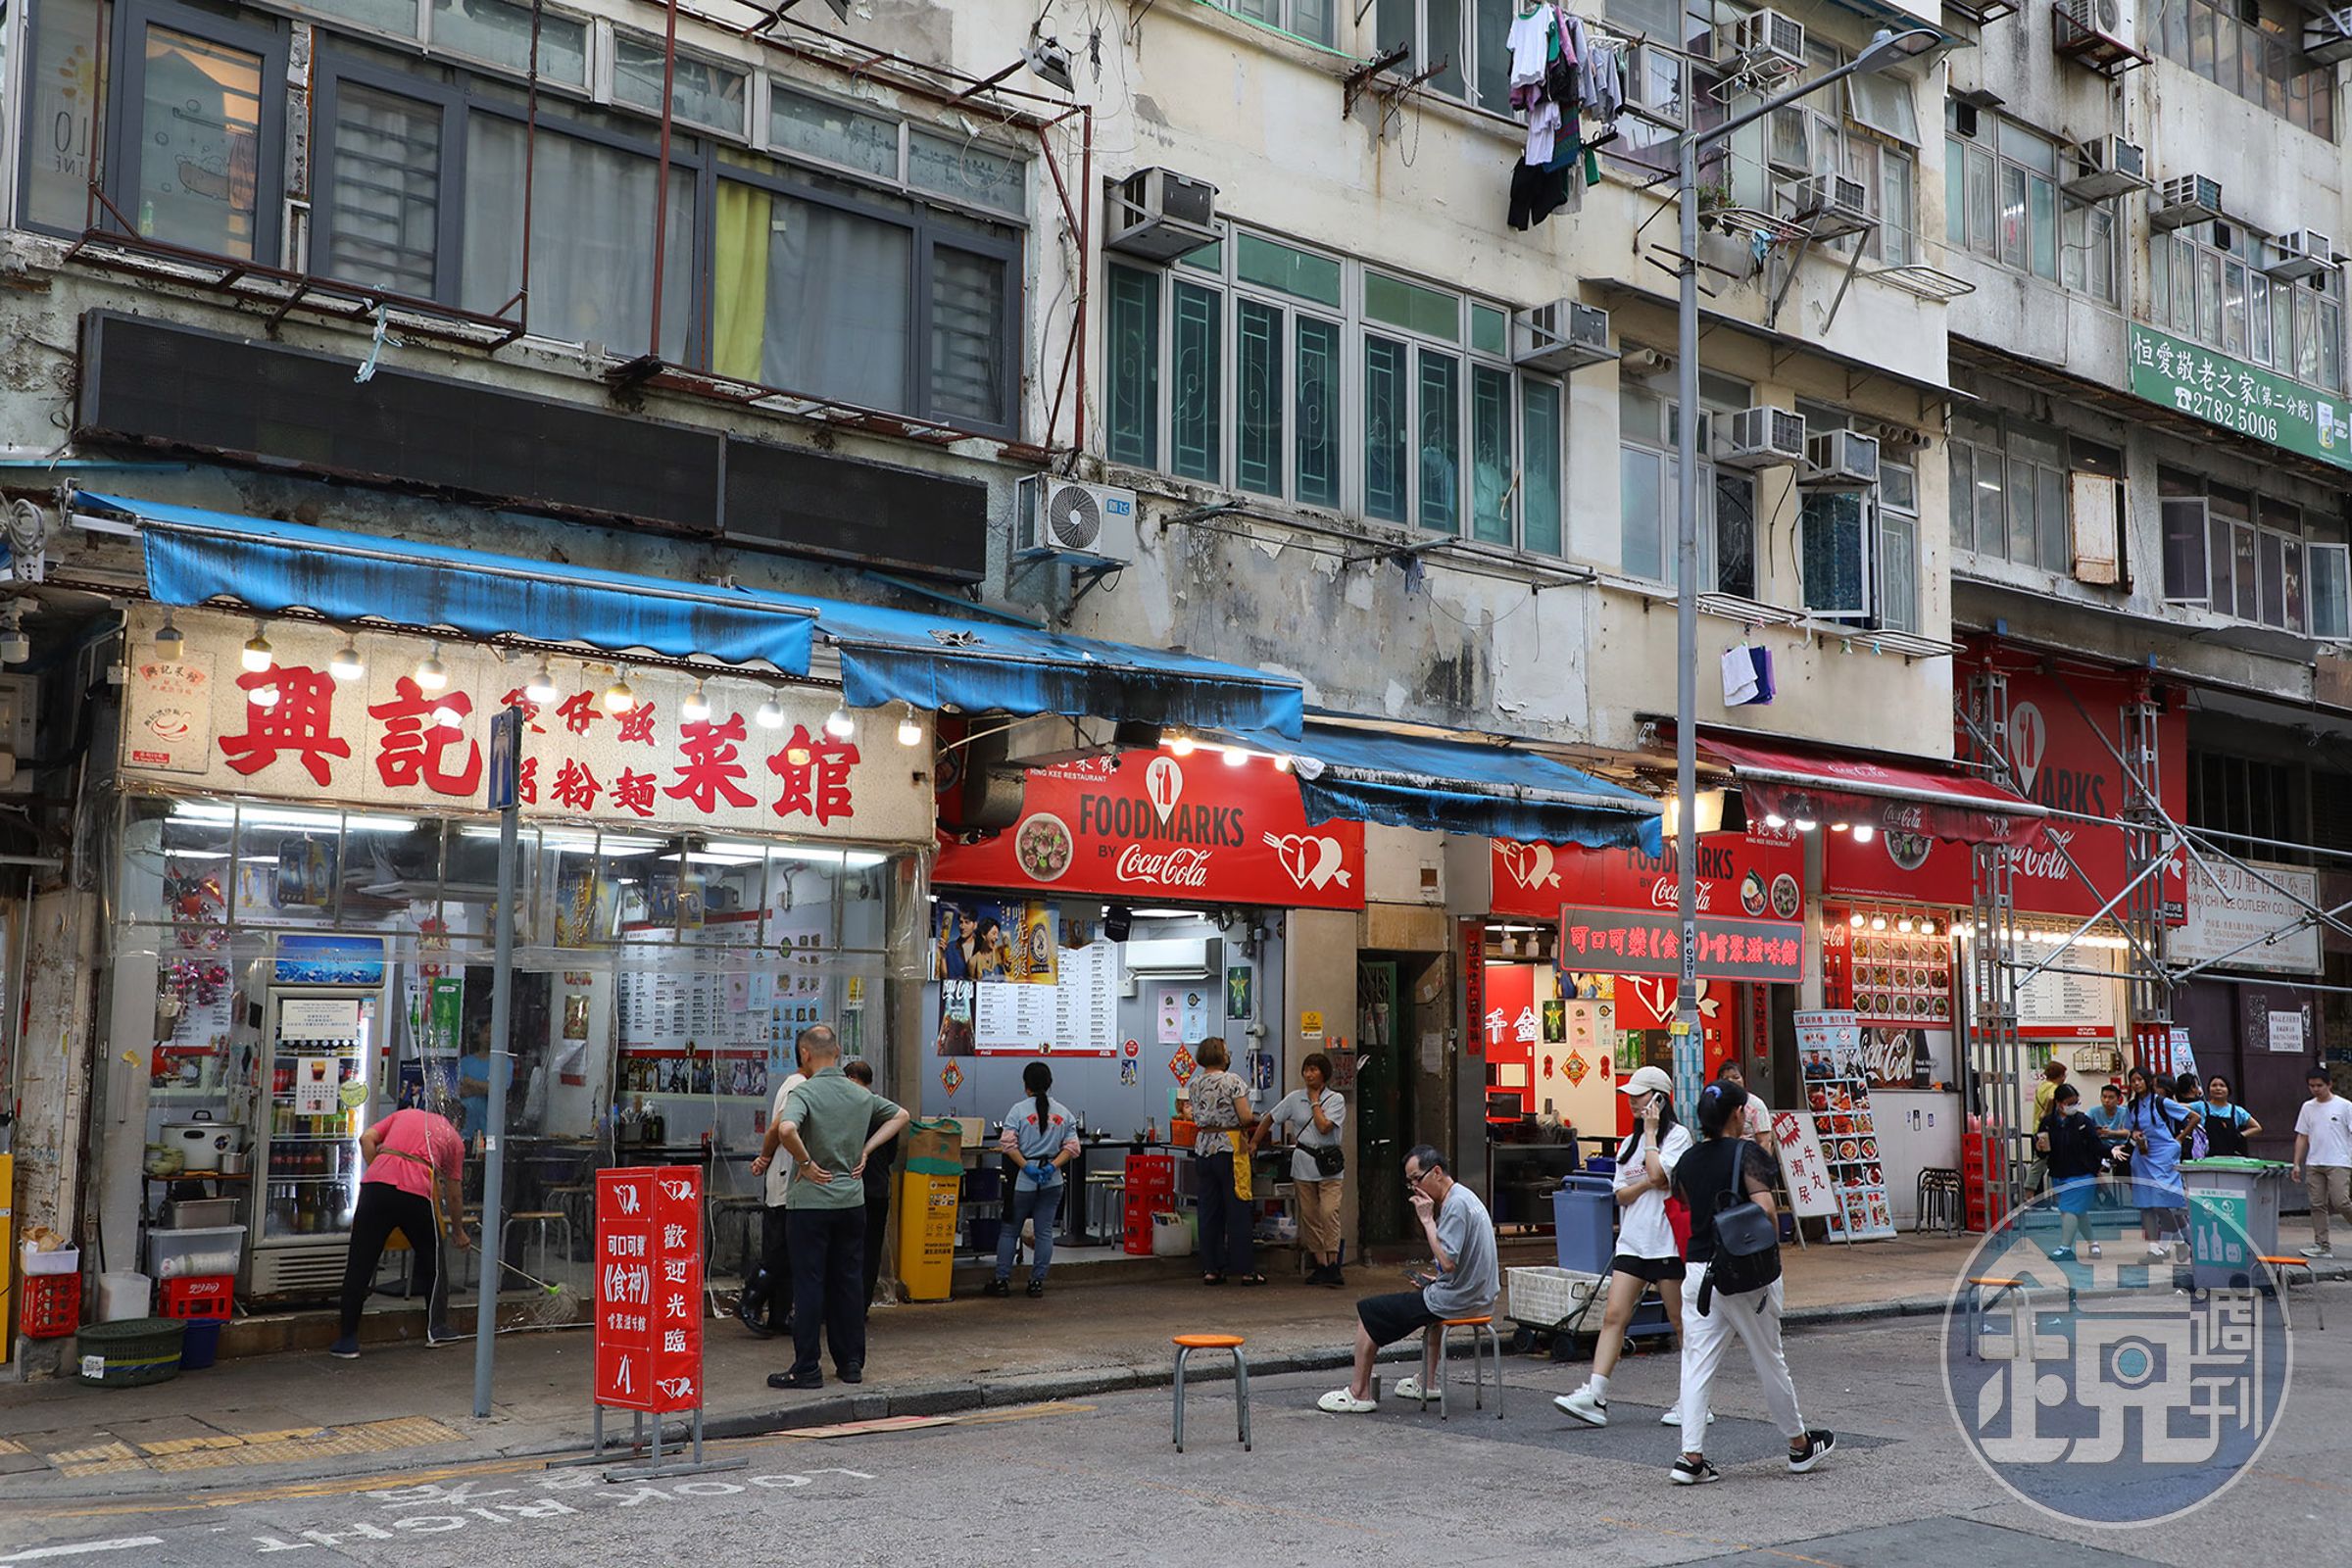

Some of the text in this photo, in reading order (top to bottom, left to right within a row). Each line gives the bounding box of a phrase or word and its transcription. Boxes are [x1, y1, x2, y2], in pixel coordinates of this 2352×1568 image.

[2193, 392, 2278, 441] 2782 5006
[218, 662, 481, 797] 興記
[662, 712, 860, 826] 菜館
[1063, 772, 1106, 782] RESTAURANT
[1080, 794, 1245, 848] FOODMARKS
[1099, 843, 1213, 888] BY Coca-Cola
[608, 1235, 646, 1257] 可口可樂
[663, 1223, 687, 1353] 歡迎光臨
[252, 1467, 875, 1553] LOOK RIGHT
